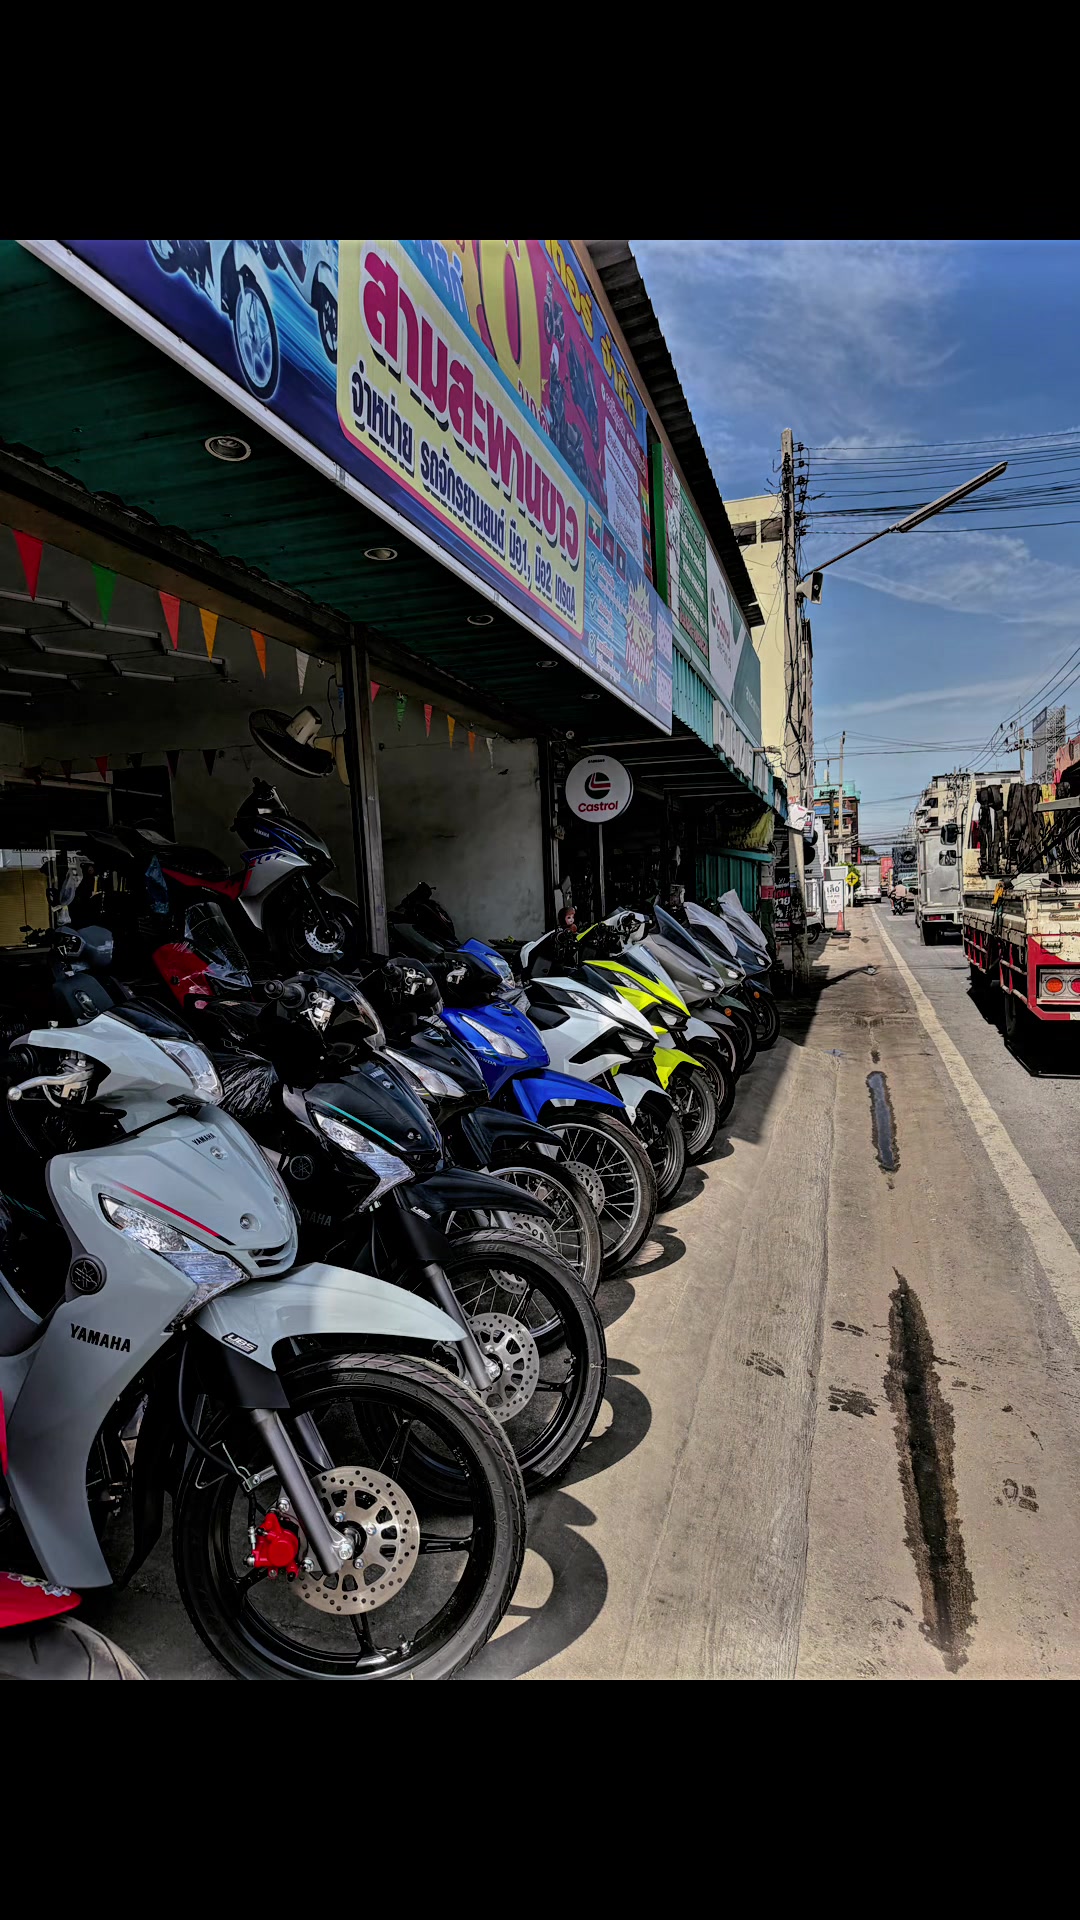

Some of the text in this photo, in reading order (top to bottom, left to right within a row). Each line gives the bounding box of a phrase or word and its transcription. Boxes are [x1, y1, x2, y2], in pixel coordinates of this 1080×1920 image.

[601, 333, 637, 430] จำกัด
[363, 251, 579, 561] สามสะพานขาว
[352, 359, 413, 467] จำหน่าย
[421, 440, 505, 551] รถจักรยานยนต์
[535, 546, 553, 592] มือ2
[578, 800, 618, 813] Castrol
[191, 1132, 216, 1146] YAMAHA
[70, 1322, 131, 1353] YAMAHA
[227, 1334, 257, 1350] UBS
